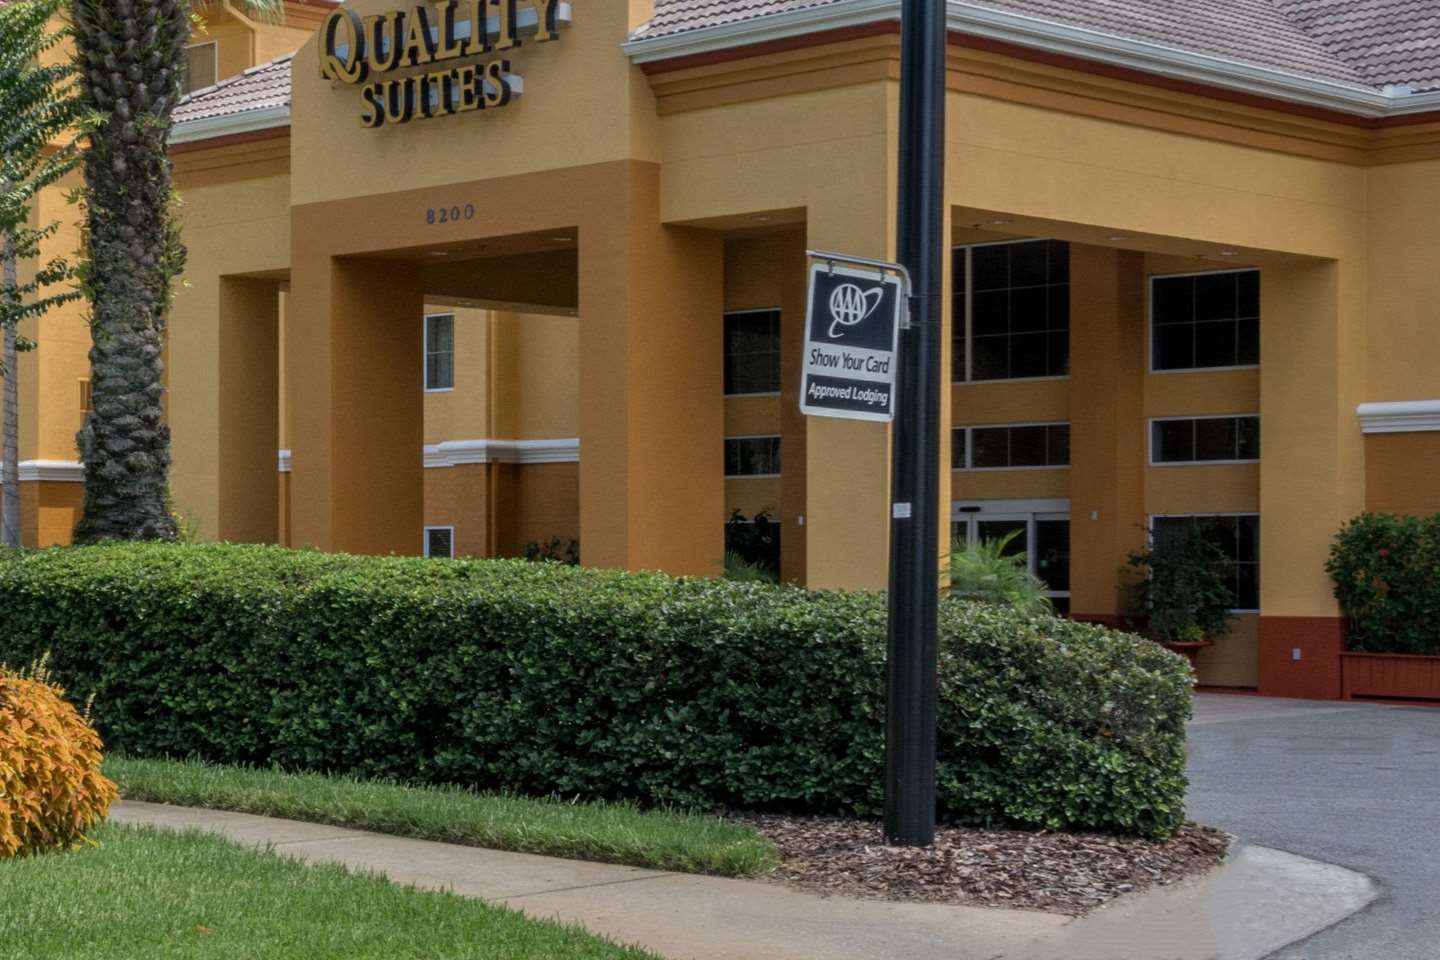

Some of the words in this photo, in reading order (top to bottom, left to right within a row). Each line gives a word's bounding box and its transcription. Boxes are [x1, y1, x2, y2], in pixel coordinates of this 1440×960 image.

[360, 60, 511, 128] SUITES
[426, 204, 474, 225] 8200
[831, 284, 865, 324] AAA
[809, 348, 839, 368] Show
[842, 352, 865, 371] Your
[865, 356, 890, 373] Card
[808, 382, 852, 399] Approved
[852, 386, 888, 406] Lodging
